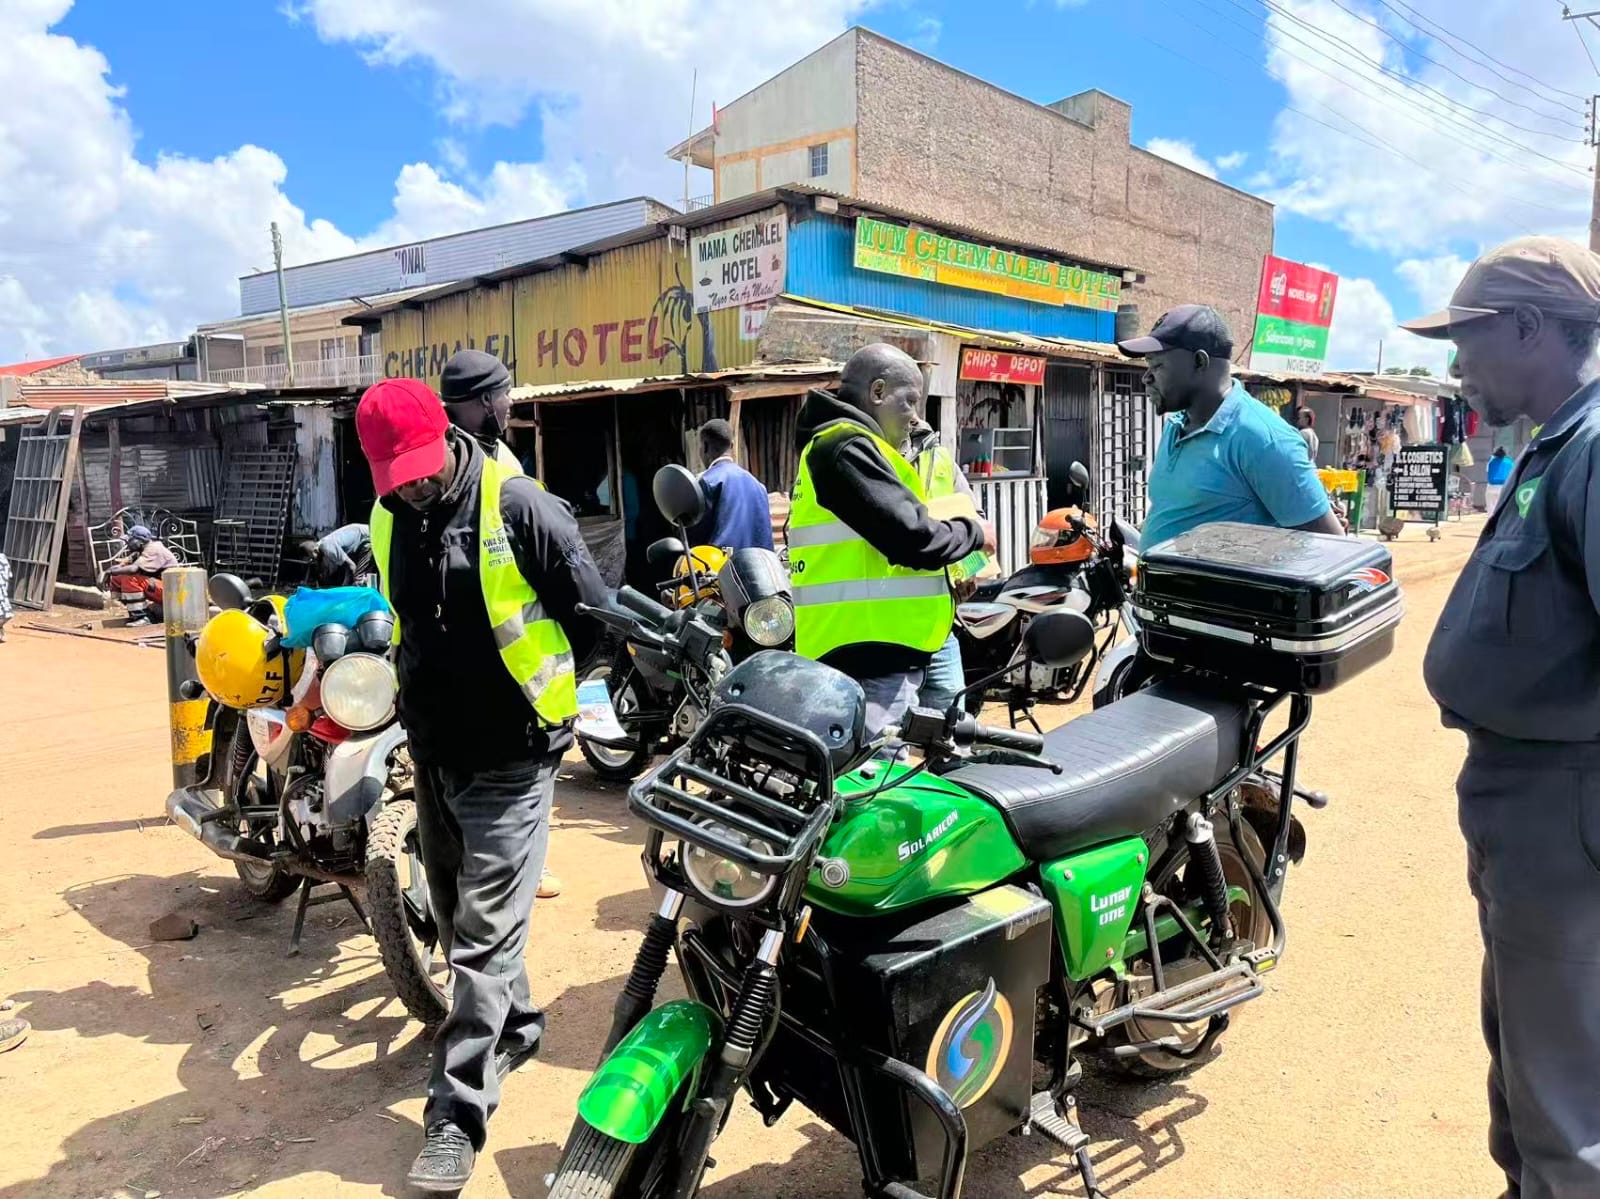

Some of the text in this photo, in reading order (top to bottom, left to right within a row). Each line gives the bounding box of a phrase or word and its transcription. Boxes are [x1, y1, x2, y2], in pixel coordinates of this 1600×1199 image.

[699, 222, 782, 262] MAMA CHEMALEL
[858, 217, 907, 255] MUM
[915, 231, 1051, 286] CHEMALEL
[722, 256, 761, 285] HOTEL
[537, 316, 673, 368] HOTEL
[964, 350, 1044, 373] CHIPS DEPOT
[1409, 464, 1431, 476] SALON
[1090, 885, 1133, 912] Lunar
[1099, 904, 1125, 926] one
